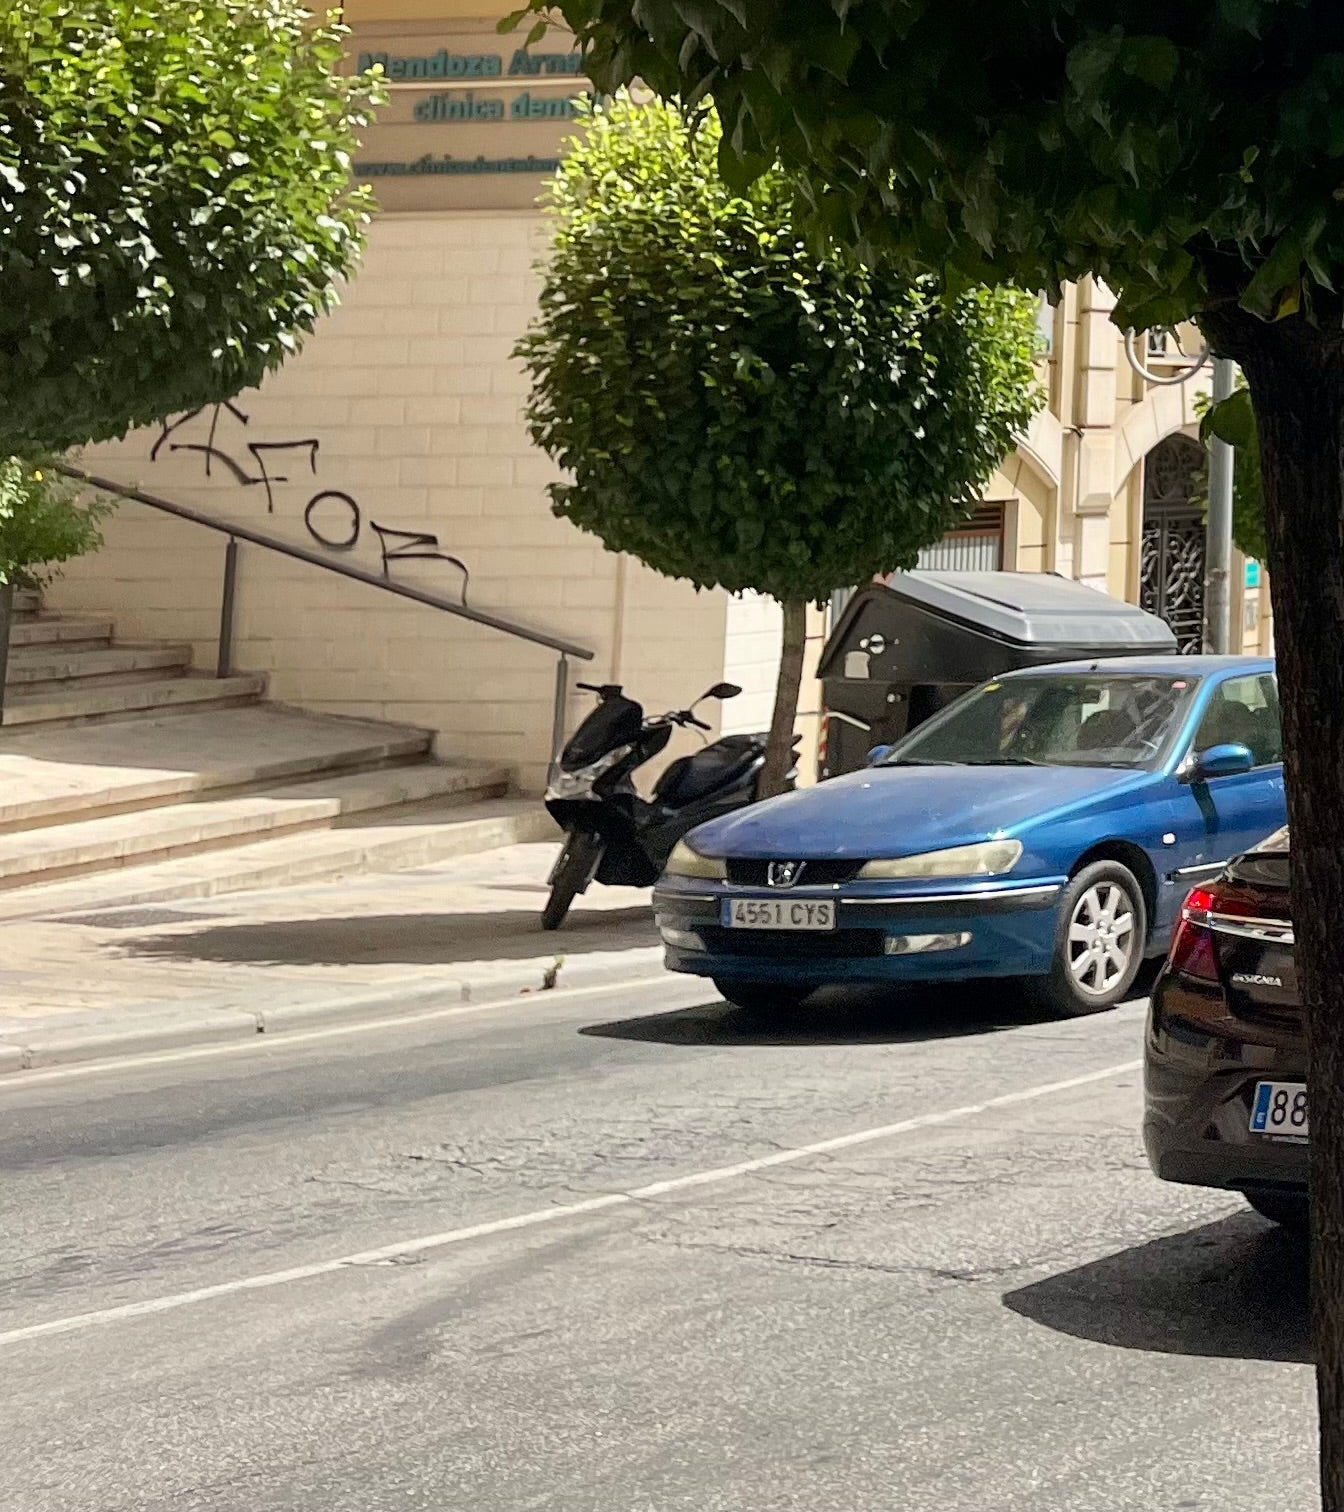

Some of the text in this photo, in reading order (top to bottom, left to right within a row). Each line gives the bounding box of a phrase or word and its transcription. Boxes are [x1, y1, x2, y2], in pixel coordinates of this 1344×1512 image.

[358, 48, 502, 79] Mendoza
[735, 903, 830, 926] 4551 CYS
